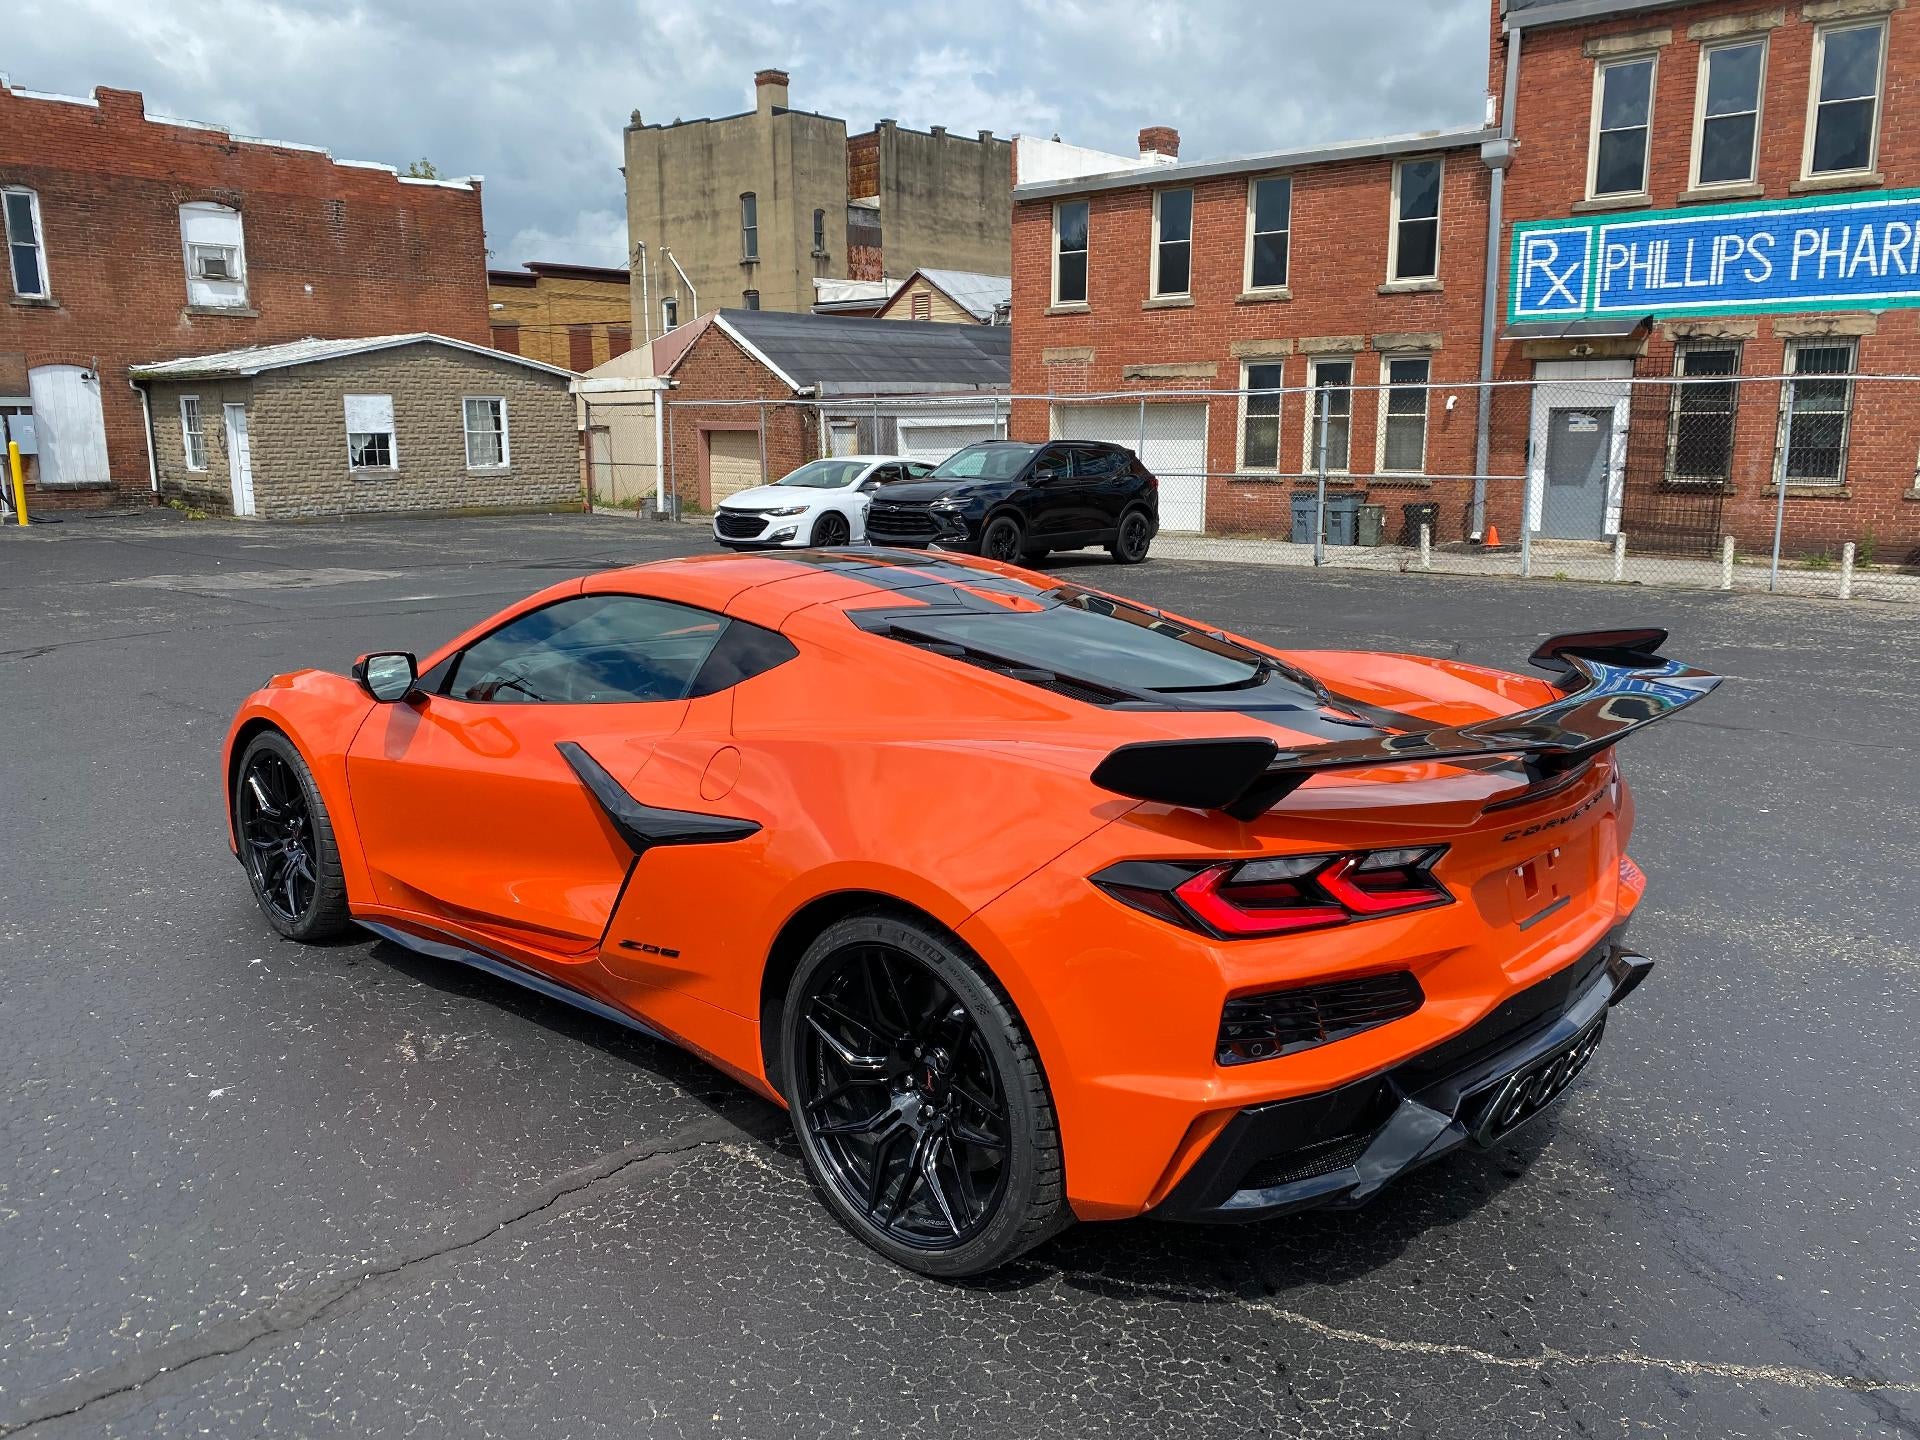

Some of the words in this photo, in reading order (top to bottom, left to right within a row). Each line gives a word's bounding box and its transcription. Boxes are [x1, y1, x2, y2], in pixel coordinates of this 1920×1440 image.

[1604, 232, 1775, 292] PHILLIPS
[1790, 220, 1920, 281] PHAR
[618, 939, 681, 959] Z06
